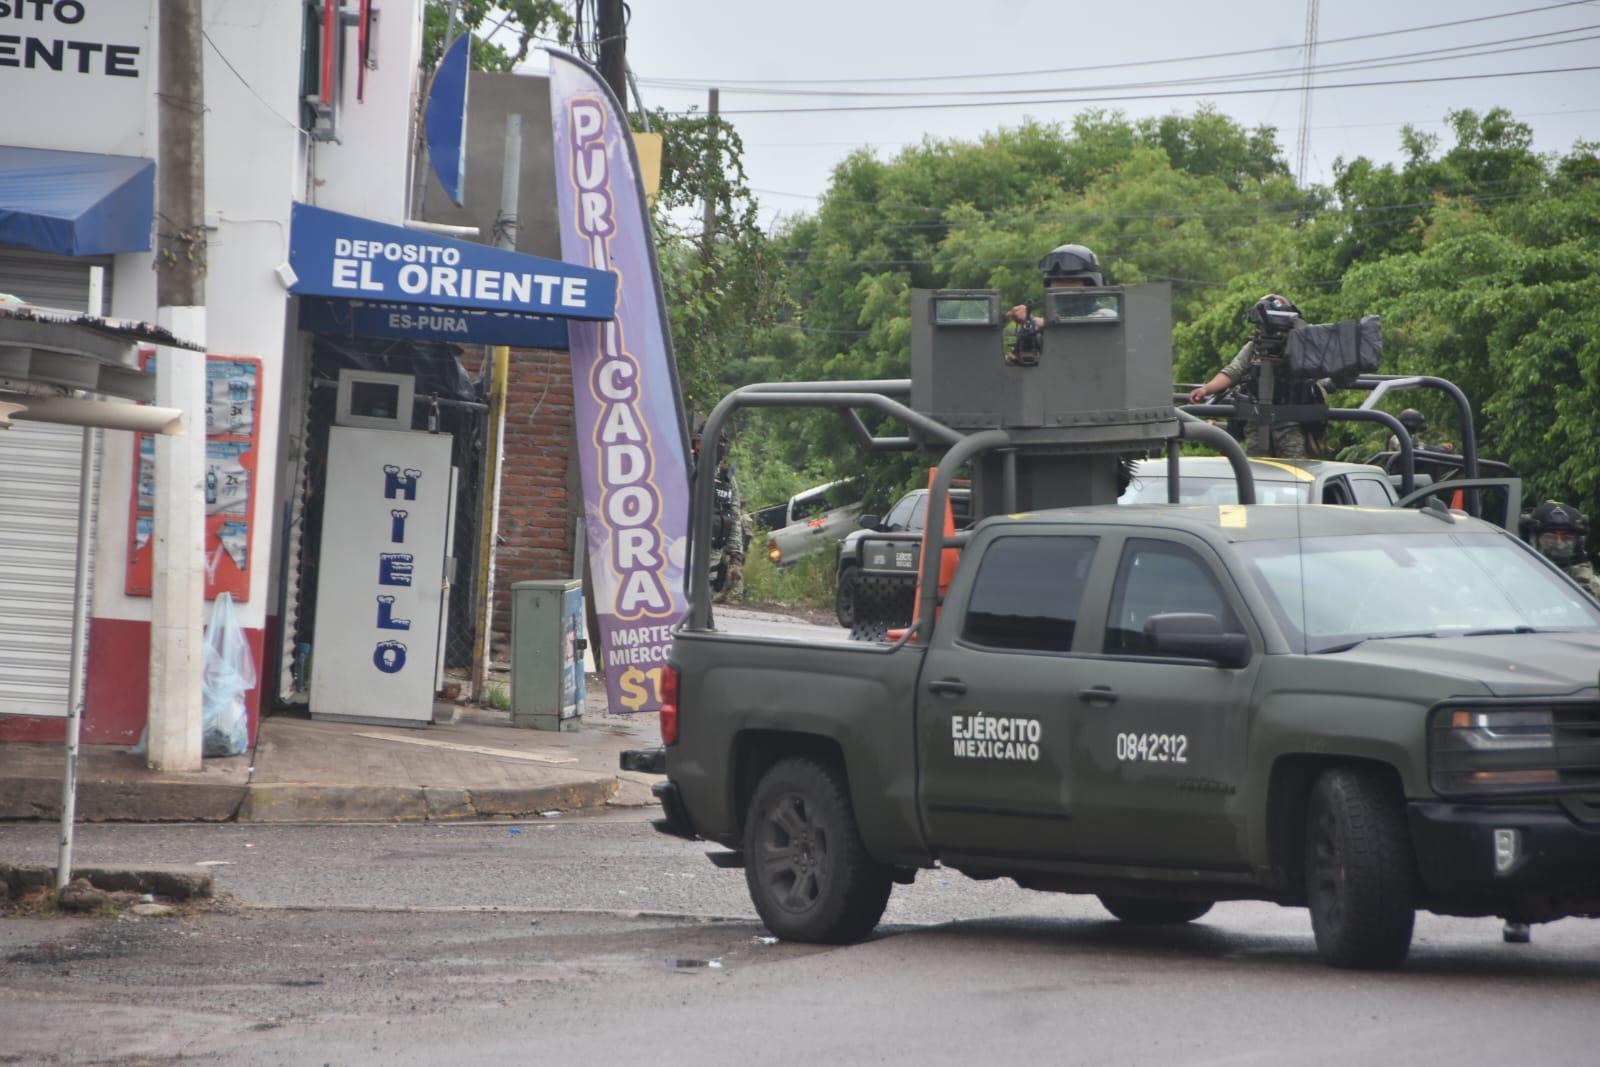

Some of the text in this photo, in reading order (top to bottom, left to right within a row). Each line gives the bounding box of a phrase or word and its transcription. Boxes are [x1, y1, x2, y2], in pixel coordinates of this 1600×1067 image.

[335, 238, 460, 266] DEPOSITO
[331, 257, 588, 308] EL ORIENTE
[388, 312, 469, 333] ES-PURA
[573, 104, 665, 611] PURIICADORA
[372, 464, 422, 674] HIELO
[951, 711, 1041, 743] EJÉRCITO
[953, 739, 1040, 761] MEXICANO
[1117, 732, 1187, 762] 0842312
